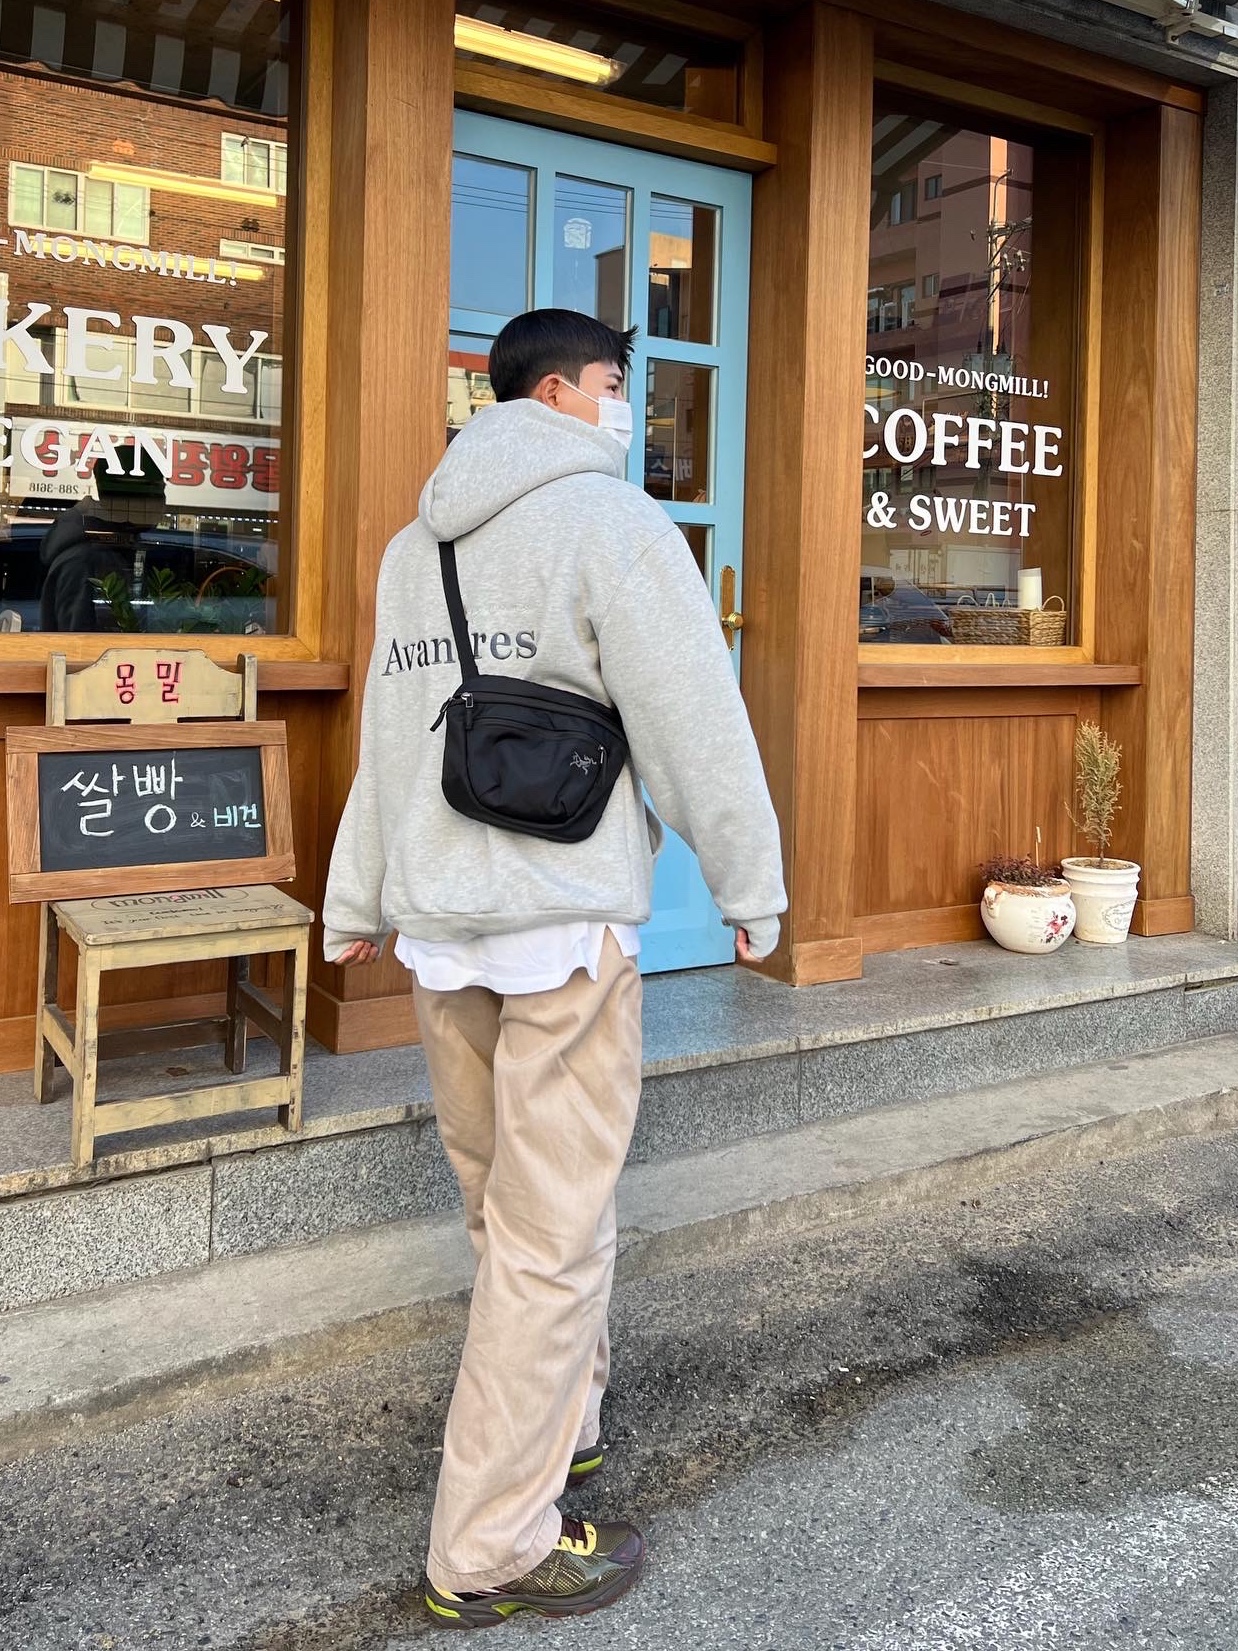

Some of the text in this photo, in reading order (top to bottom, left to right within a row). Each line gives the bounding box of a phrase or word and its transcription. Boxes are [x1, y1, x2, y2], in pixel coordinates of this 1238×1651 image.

[0, 417, 180, 477] GAN
[866, 491, 1036, 537] & SWEET
[381, 630, 538, 677] Avanres
[190, 812, 206, 828] &
[213, 803, 262, 829] 비건
